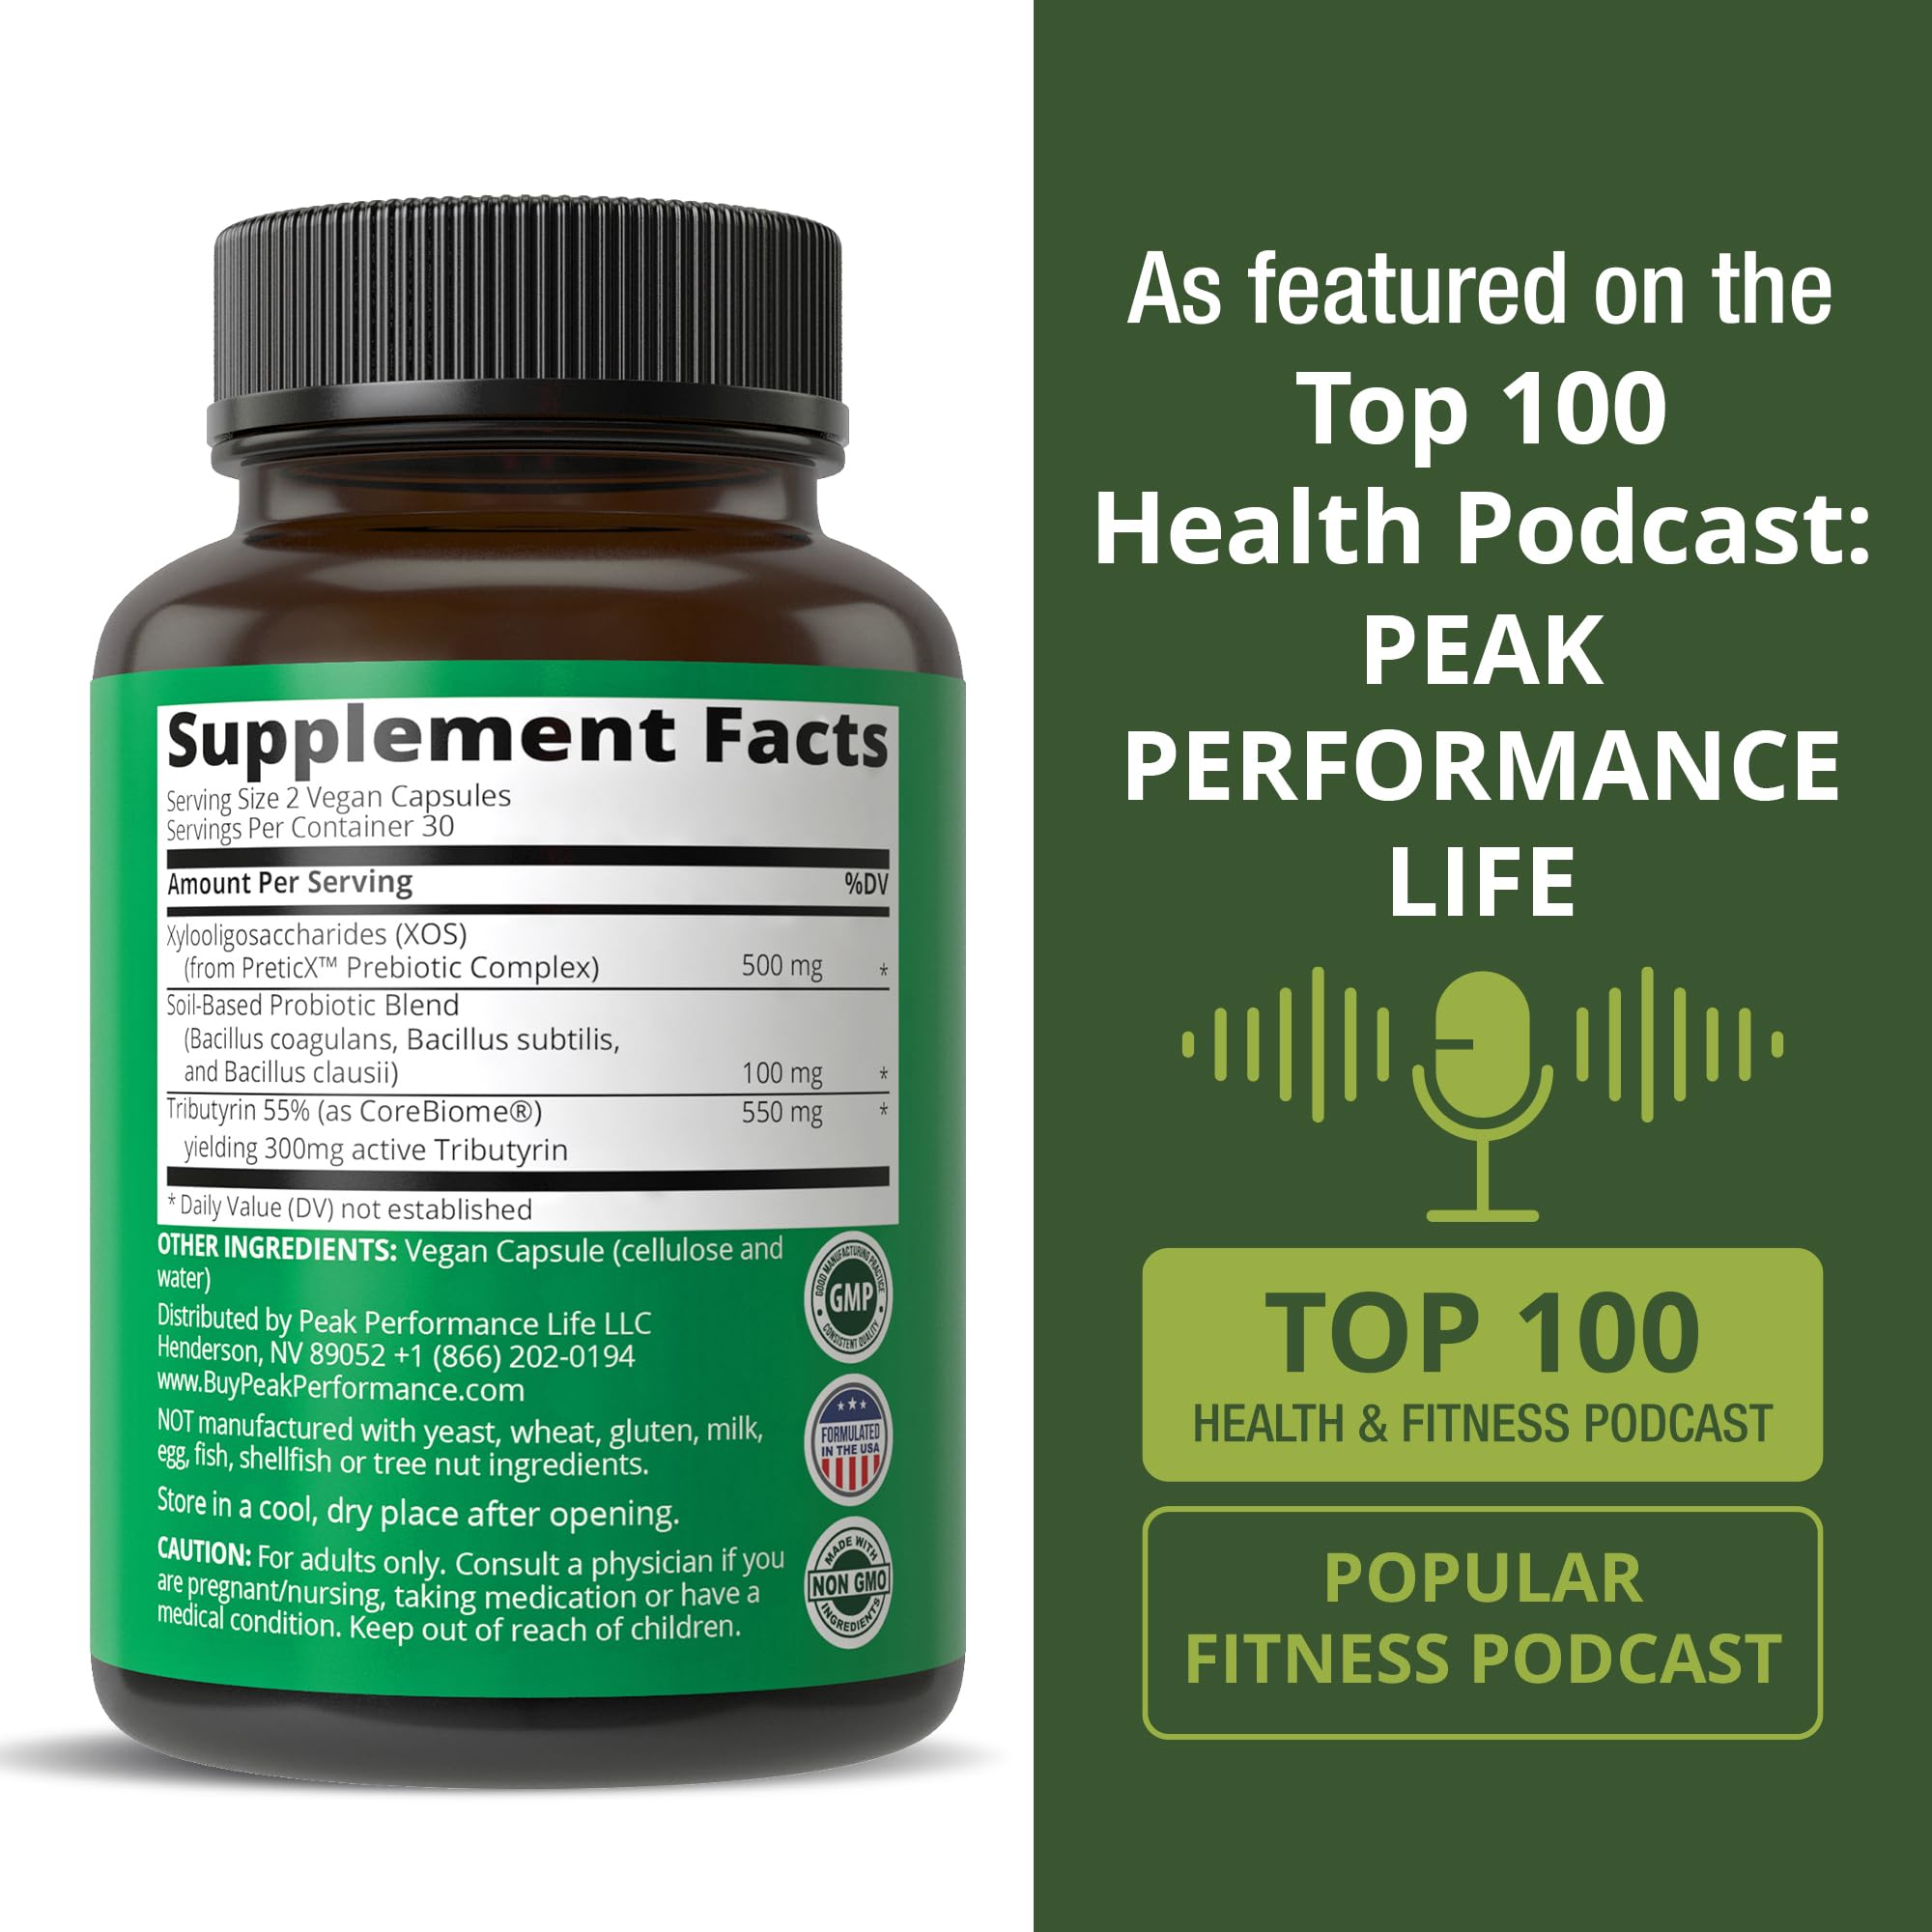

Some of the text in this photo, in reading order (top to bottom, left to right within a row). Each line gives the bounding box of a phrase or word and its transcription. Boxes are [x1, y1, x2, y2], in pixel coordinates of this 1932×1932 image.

[169, 703, 888, 782] Supplement Facts
[167, 782, 511, 816] Serving Size 2 Vegan Capsules
[167, 814, 454, 846] Servings Per Container 30
[168, 868, 412, 899] Amount Per Serving
[845, 871, 889, 895] %DV
[167, 922, 467, 952] Xylooligosaccharides (XOS)
[185, 955, 234, 982] (from
[348, 955, 462, 979] Prebiotic
[471, 954, 599, 985] Complex)
[743, 953, 823, 982] 500 mg
[167, 992, 458, 1016] Soil-Based Probiotic Blend
[184, 1026, 619, 1057] (Bacillus coagulans, Bacillus subtilis,
[185, 1060, 398, 1088] and Bacillus clausii)
[744, 1062, 823, 1090] 100 mg
[166, 1097, 255, 1126] Tributyrin
[264, 1099, 309, 1121] 55%
[319, 1099, 352, 1125] (as
[743, 1100, 823, 1128] 550 mg
[185, 1135, 567, 1168] yielding 300mg active Tributyrin
[182, 1194, 531, 1222] Daily Value (DV) not established
[158, 1233, 781, 1268] OTHER INGREDIENTS: Vegan Capsule (cellulose and
[157, 1267, 210, 1293] water)
[815, 1245, 885, 1296] GOOD MANUFACTURING PRACTICE
[830, 1282, 873, 1312] GMP
[158, 1303, 650, 1338] Distributed by Peak Performance Life LLC
[823, 1320, 879, 1349] CONSISTENT QUALITY
[158, 1335, 635, 1373] Henderson, NV 89052 +1 (866) 202-0194
[157, 1371, 524, 1401] www.BuyPeakPerformance.com
[158, 1407, 762, 1449] NOT manufactured with yeast, wheat, gluten, milk,
[821, 1423, 879, 1443] FORMULATED
[158, 1441, 649, 1480] egg, fish, shellfish or tree nut ingredients.
[821, 1443, 879, 1457] IN THE USA
[158, 1486, 678, 1534] Store in a cool, dry place after opening.
[158, 1536, 783, 1581] CAUTION: For adults only. Consult a physician if you
[825, 1536, 878, 1565] MADE WITH
[158, 1574, 758, 1615] are pregnant/nursing, taking medication or have a
[812, 1569, 887, 1597] NON GMO
[158, 1603, 740, 1646] medical condition. Keep out of reach of children.
[821, 1598, 880, 1632] INGREDIENTS
